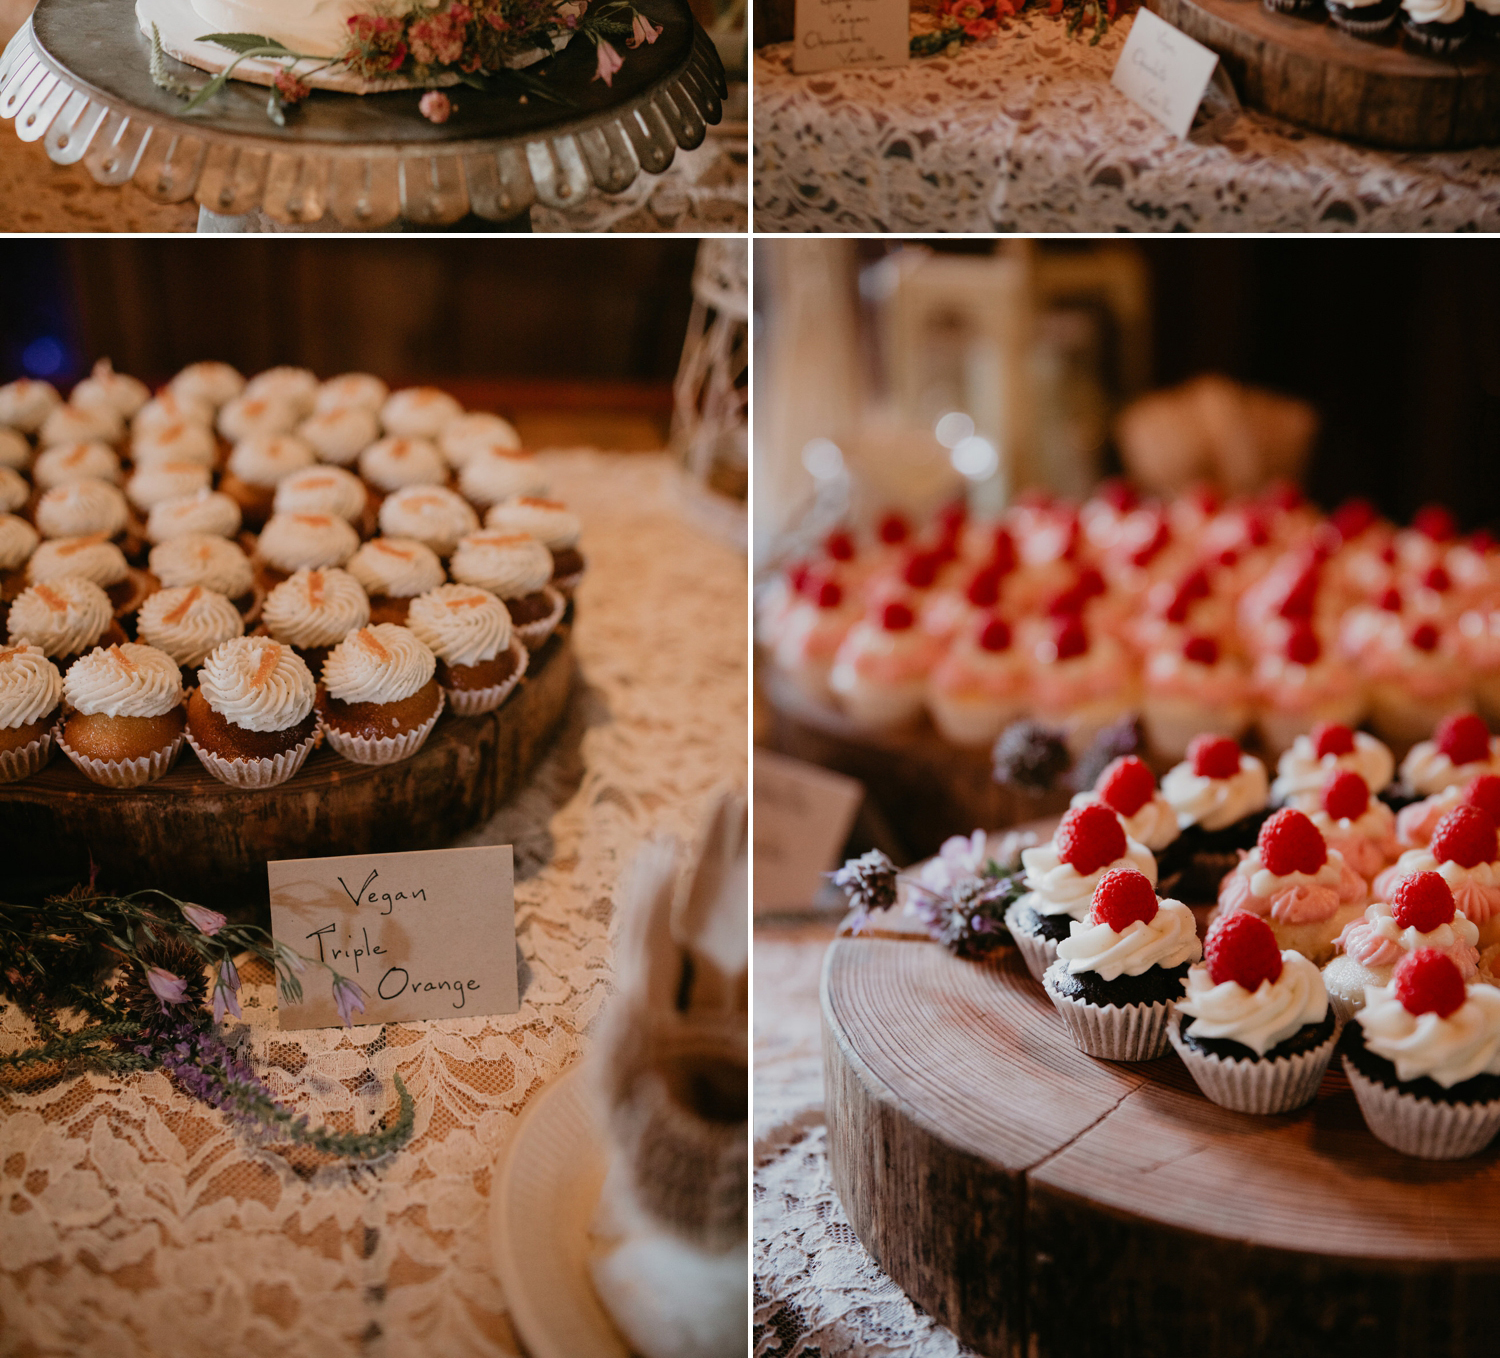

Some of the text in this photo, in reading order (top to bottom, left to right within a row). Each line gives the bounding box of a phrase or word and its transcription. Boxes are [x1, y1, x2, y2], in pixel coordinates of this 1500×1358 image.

[338, 869, 427, 915] Vegan
[306, 923, 387, 973] Triple
[378, 966, 480, 1009] Orange
